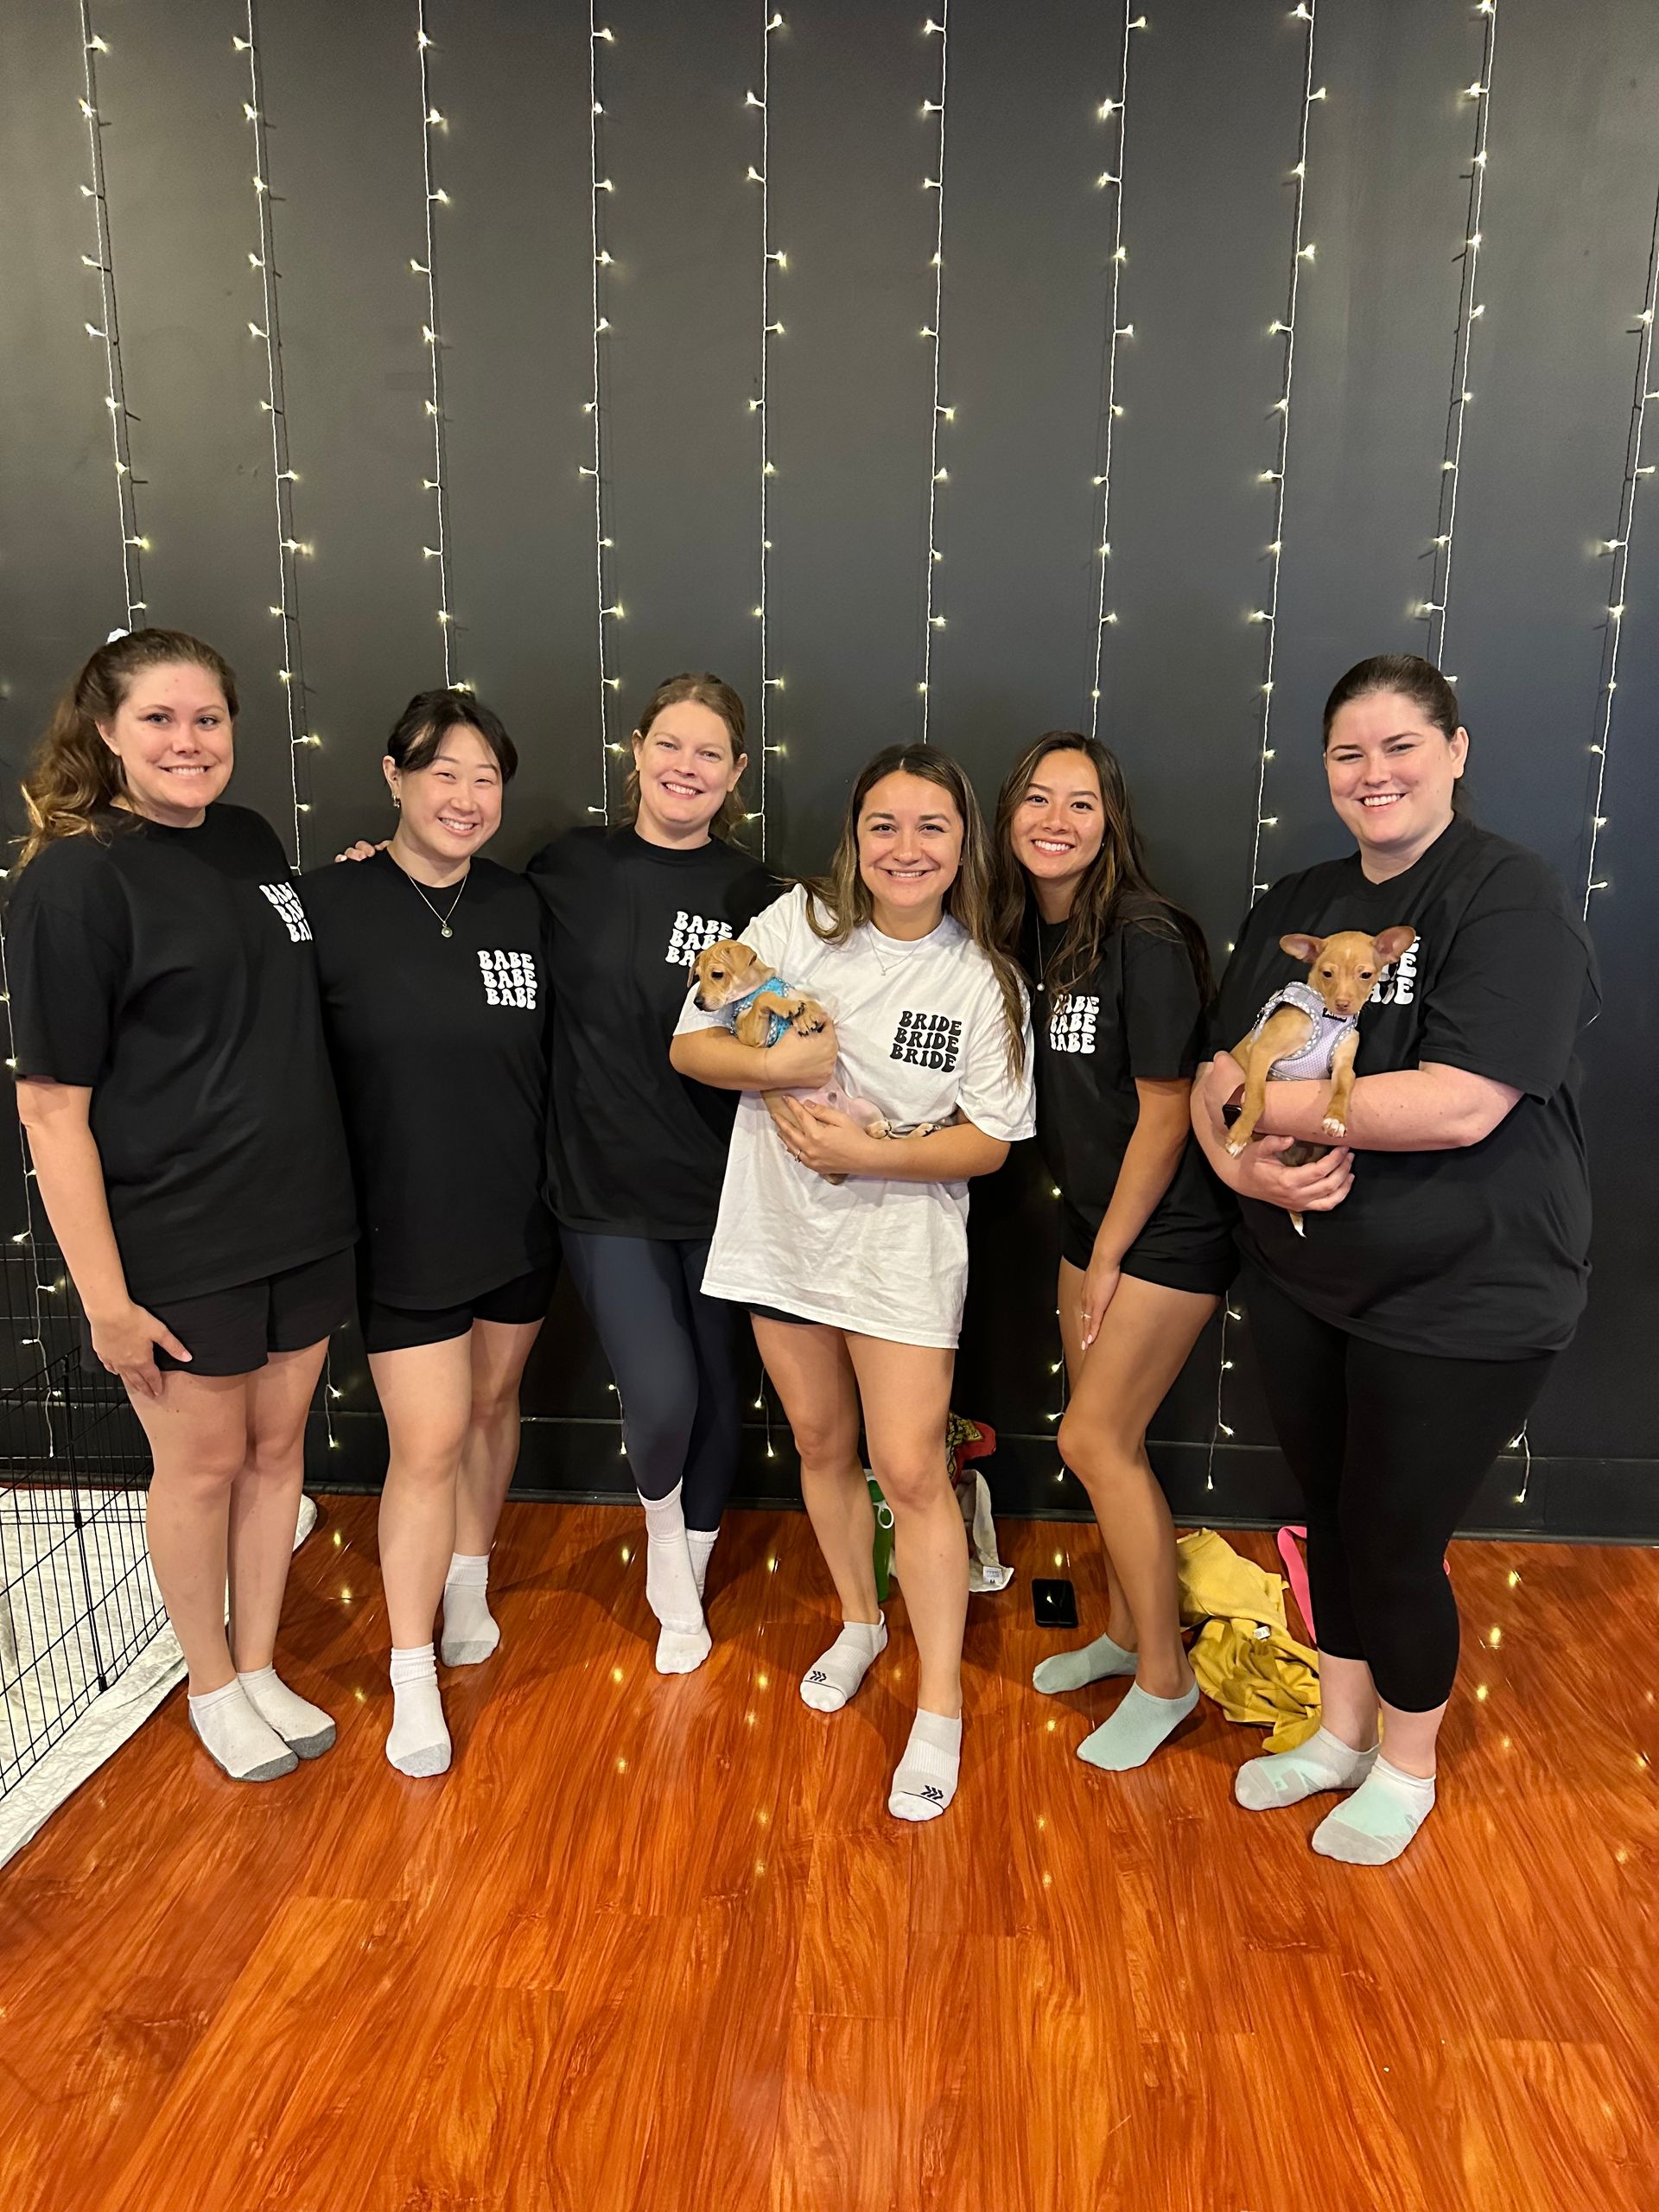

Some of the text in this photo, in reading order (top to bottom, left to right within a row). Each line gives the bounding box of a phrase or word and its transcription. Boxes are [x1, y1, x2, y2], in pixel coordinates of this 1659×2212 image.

[273, 898, 304, 923] BAB
[673, 911, 733, 938] BABE
[669, 928, 729, 950] BAB
[477, 950, 535, 970] BABE
[664, 945, 696, 968] BA
[480, 968, 537, 989] BABE
[485, 987, 537, 1009] BABE
[899, 1010, 963, 1036] BRIDE
[893, 1027, 959, 1054] BRIDE
[889, 1043, 957, 1073] BRIDE
